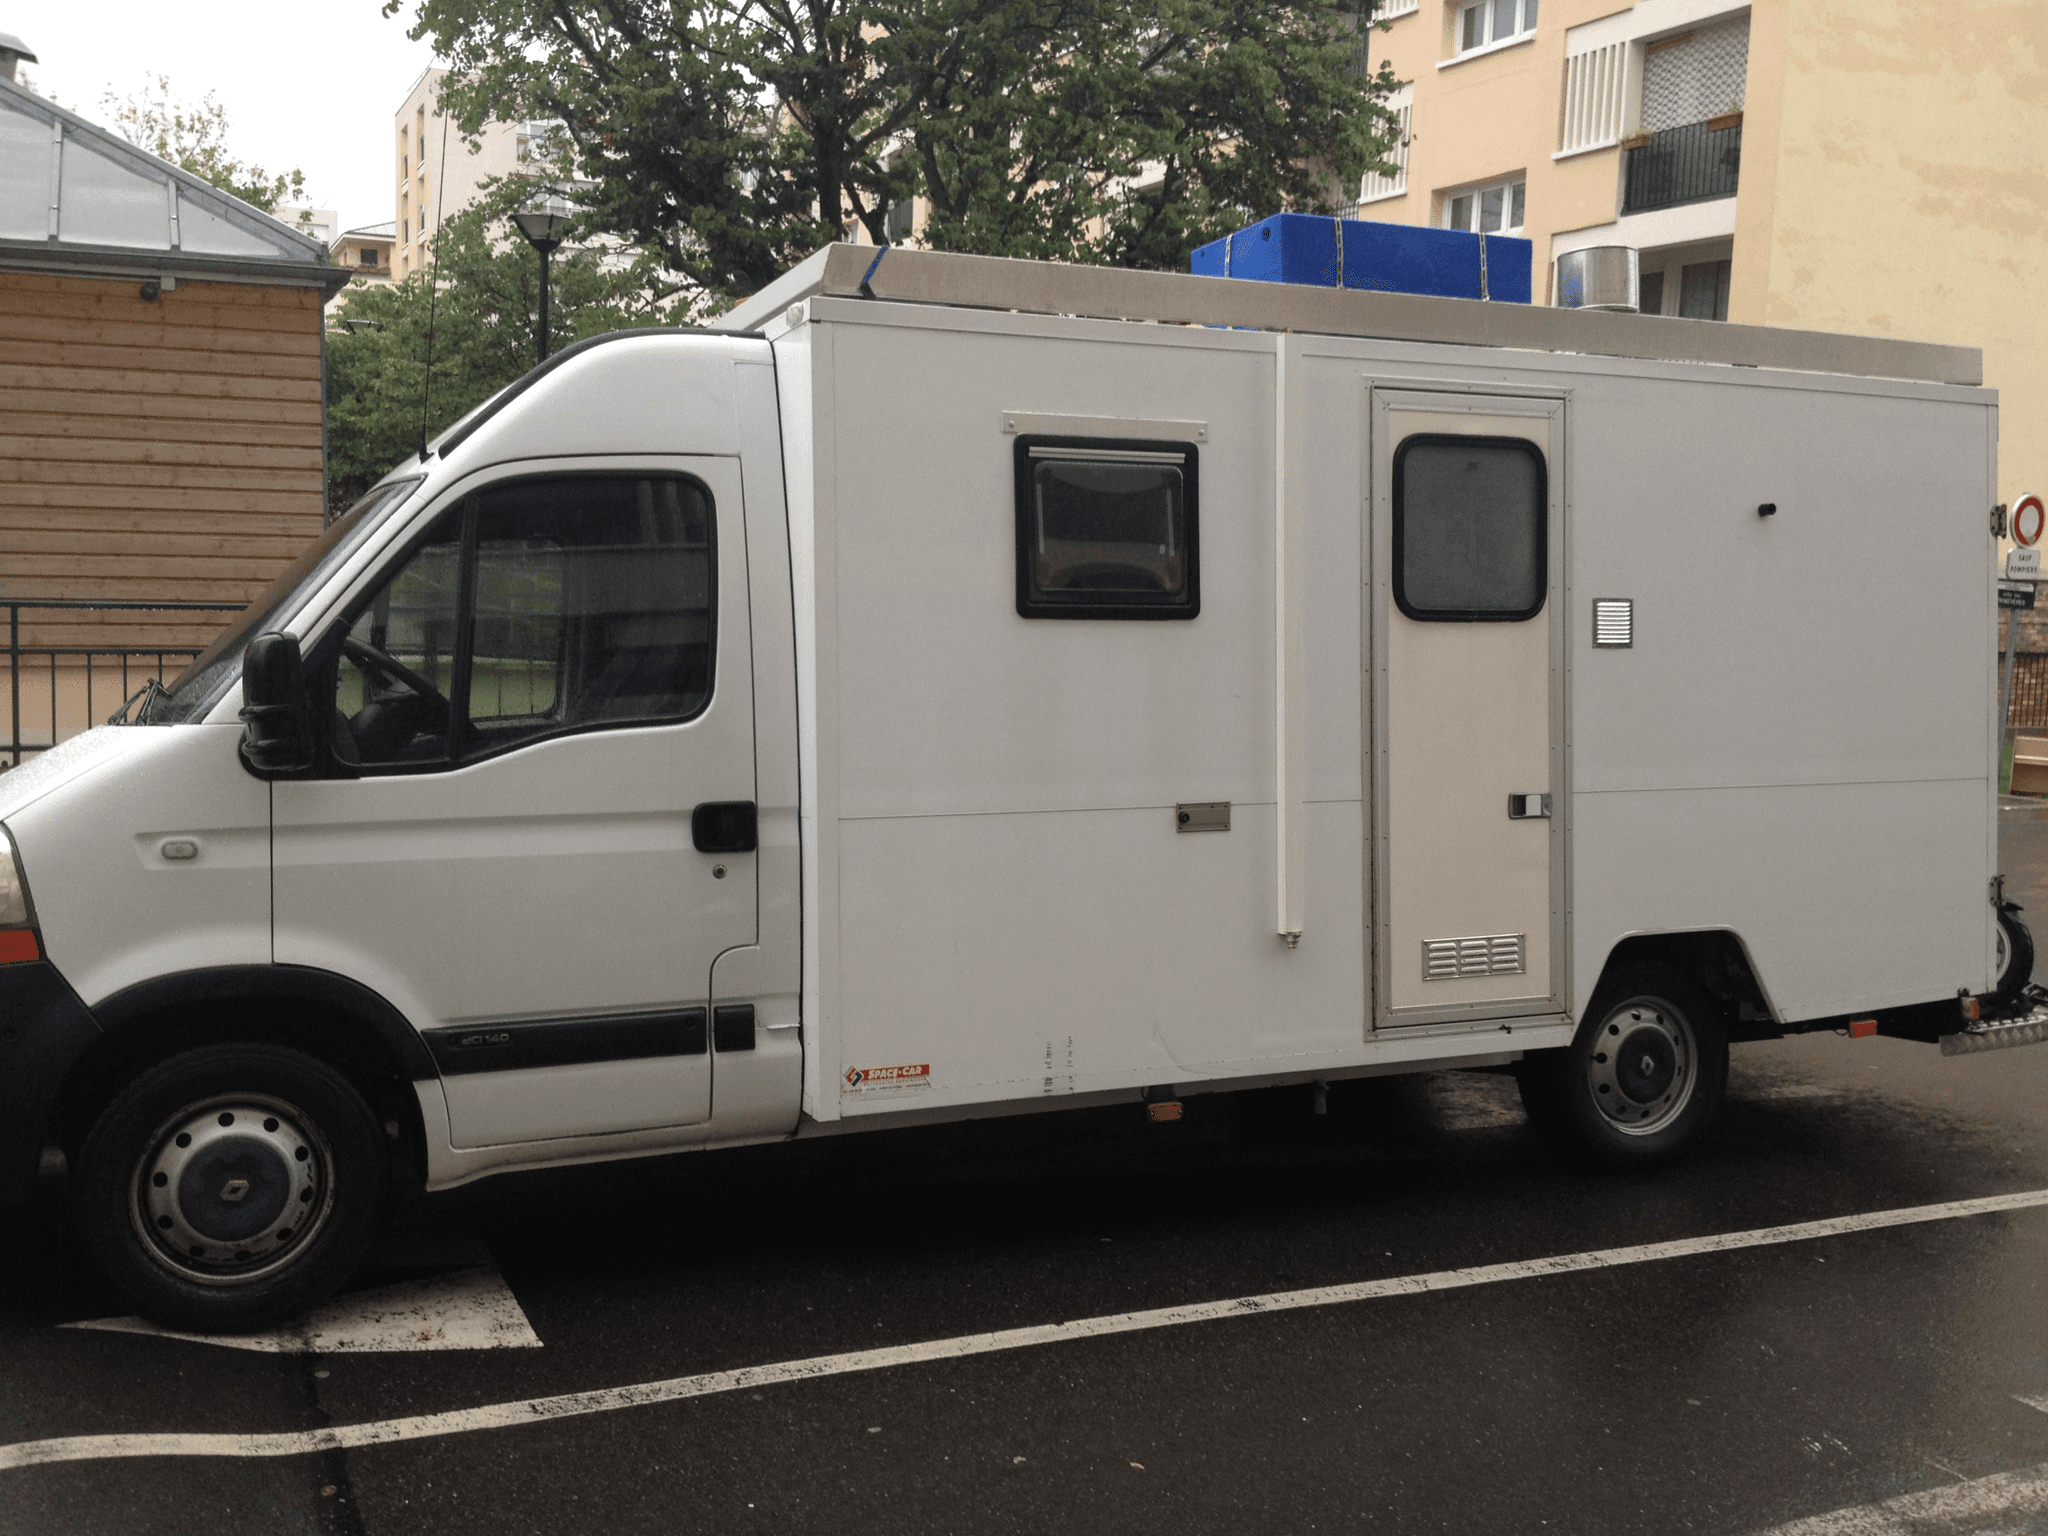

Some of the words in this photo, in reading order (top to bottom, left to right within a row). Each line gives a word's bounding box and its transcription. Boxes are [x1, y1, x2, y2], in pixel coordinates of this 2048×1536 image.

[2018, 554, 2032, 562] SAUF
[2010, 565, 2038, 574] POMPIERS
[485, 1033, 509, 1043] 140
